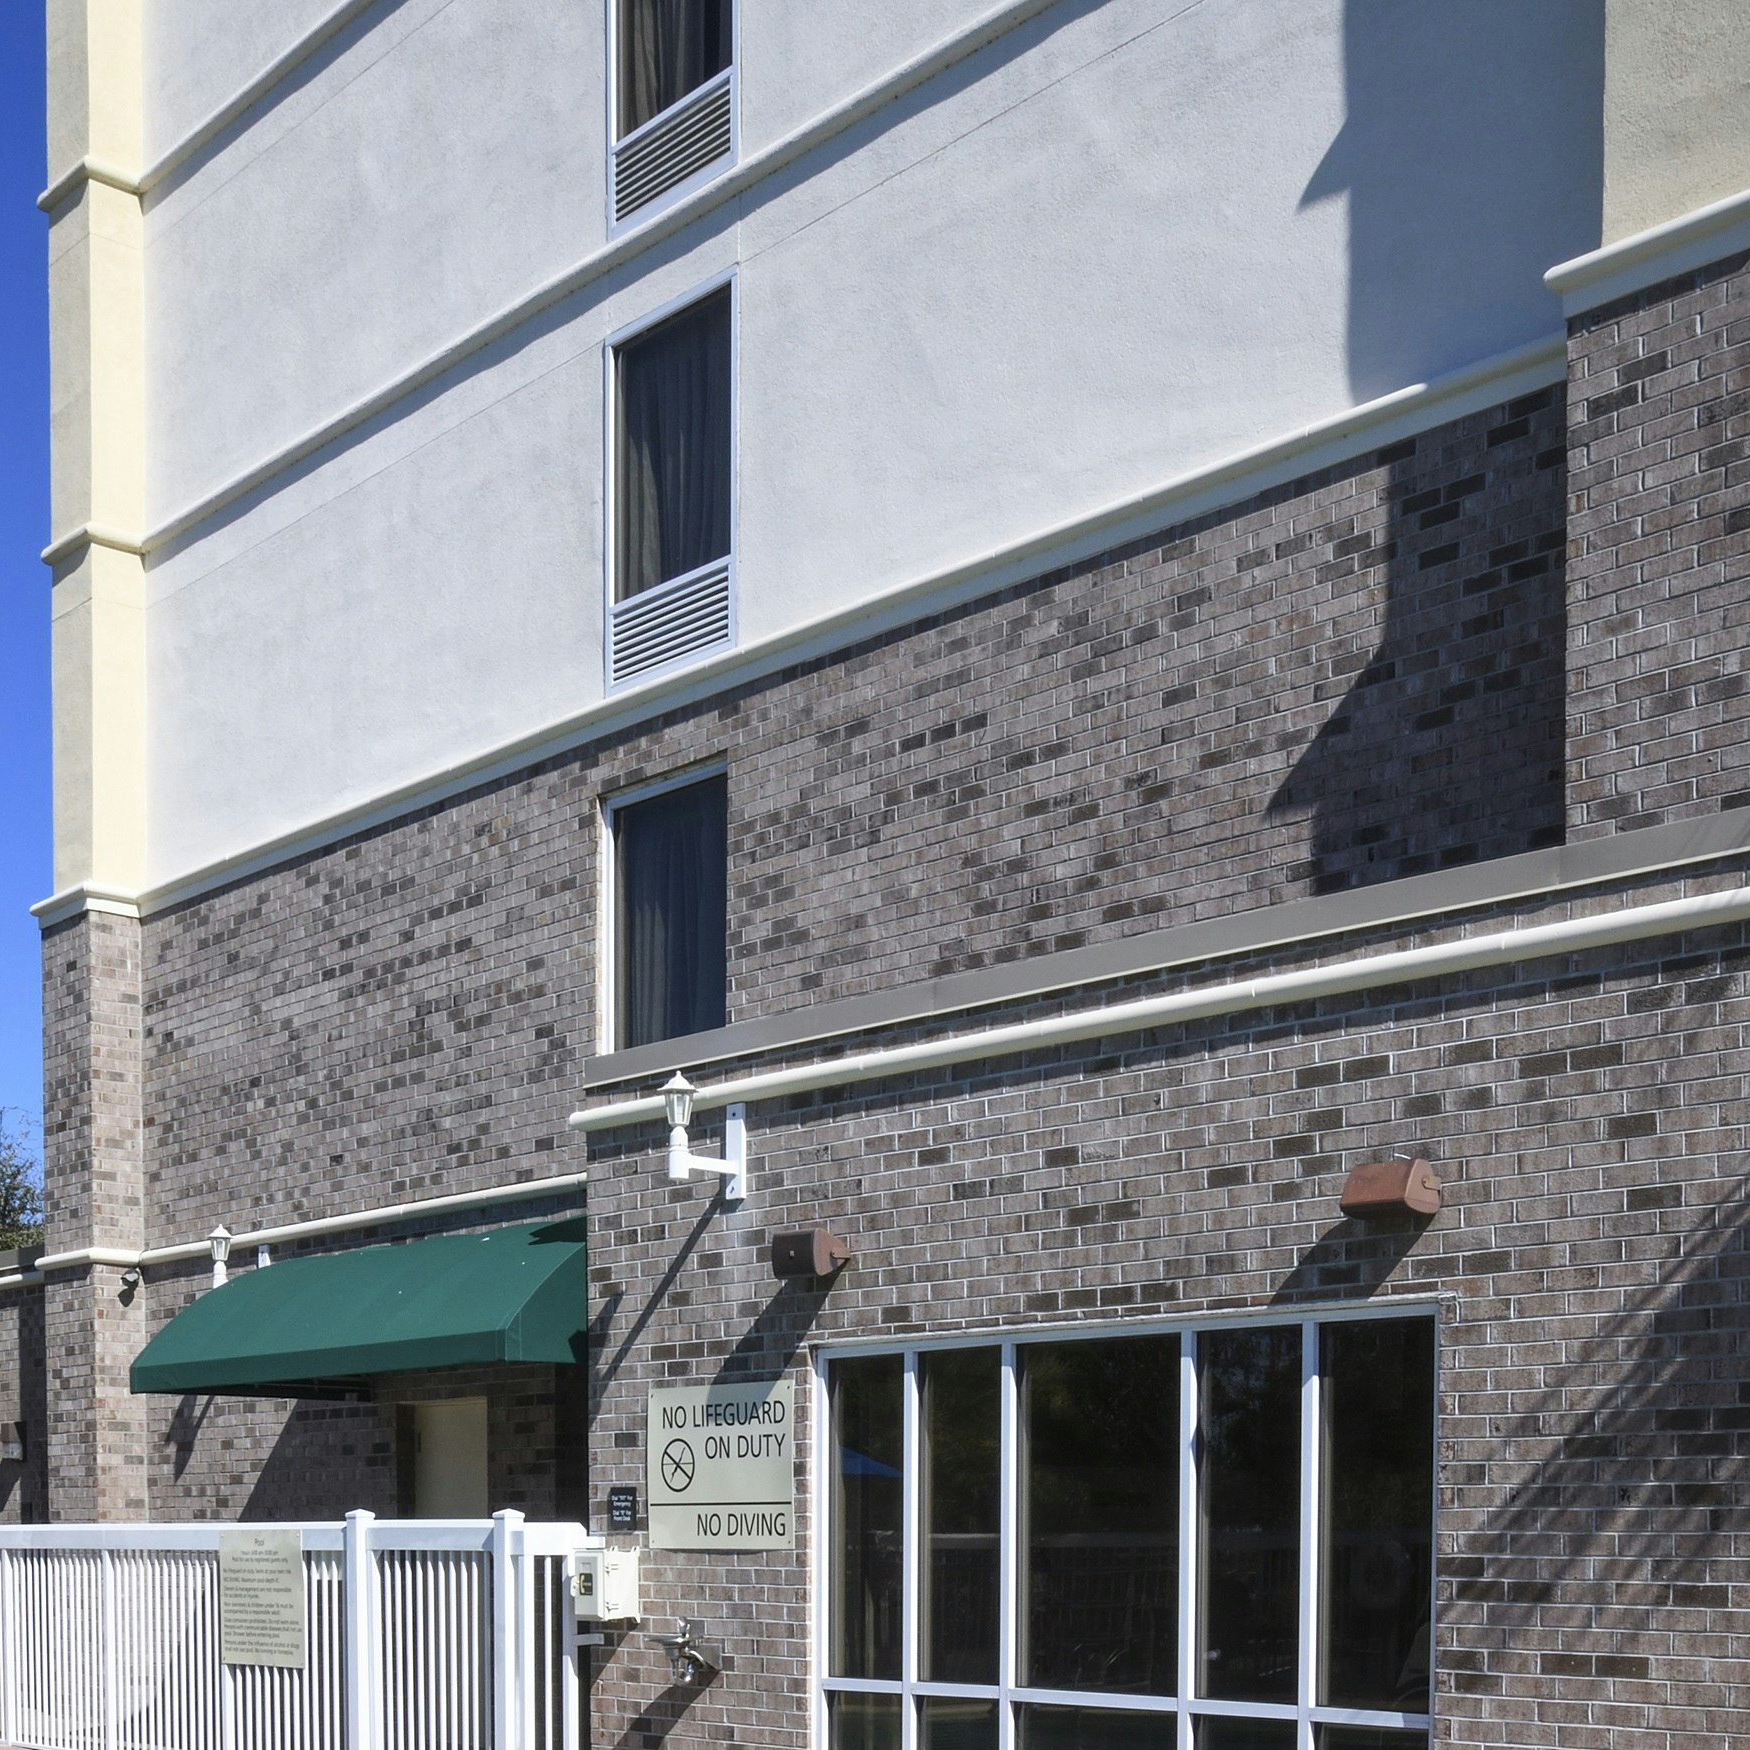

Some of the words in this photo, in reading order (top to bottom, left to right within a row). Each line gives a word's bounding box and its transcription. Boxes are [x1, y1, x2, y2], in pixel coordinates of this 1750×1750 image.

[662, 1405, 687, 1429] NO
[693, 1400, 785, 1428] LIFEGUARD
[705, 1436, 730, 1459] ON
[737, 1433, 786, 1459] DUTY
[697, 1514, 722, 1536] NO
[727, 1513, 786, 1537] DIVING
